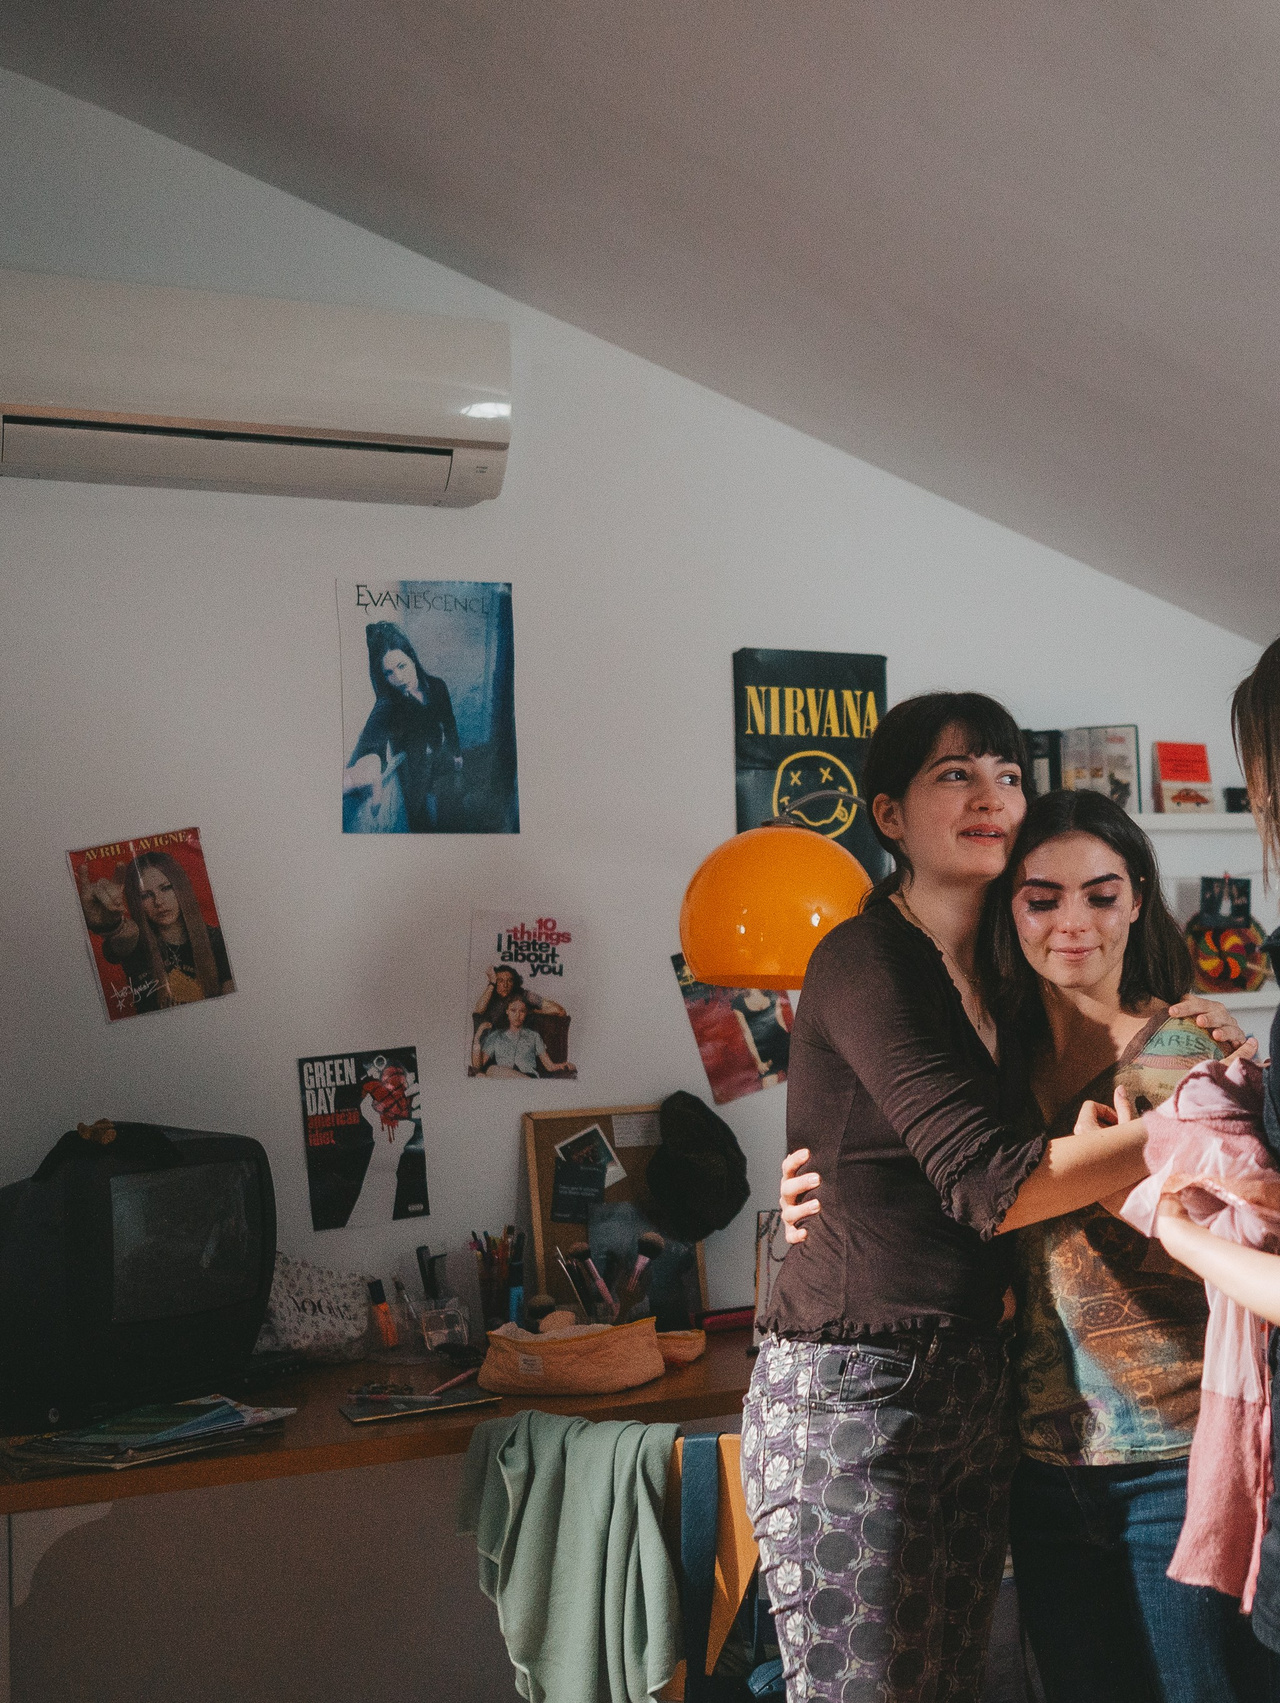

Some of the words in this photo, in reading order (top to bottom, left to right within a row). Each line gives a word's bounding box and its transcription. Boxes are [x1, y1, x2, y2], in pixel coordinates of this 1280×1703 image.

[745, 686, 880, 739] NIRVANA
[85, 844, 126, 863] AVRIL
[506, 922, 571, 945] things
[536, 917, 557, 931] 10
[497, 933, 502, 952] I
[507, 934, 550, 953] hate
[501, 947, 559, 964] about
[530, 963, 563, 977] you
[1152, 1034, 1207, 1051] ARIS
[303, 1057, 357, 1090] GREEN
[305, 1086, 336, 1117] DAY
[307, 1109, 360, 1130] american
[308, 1128, 336, 1147] idiot
